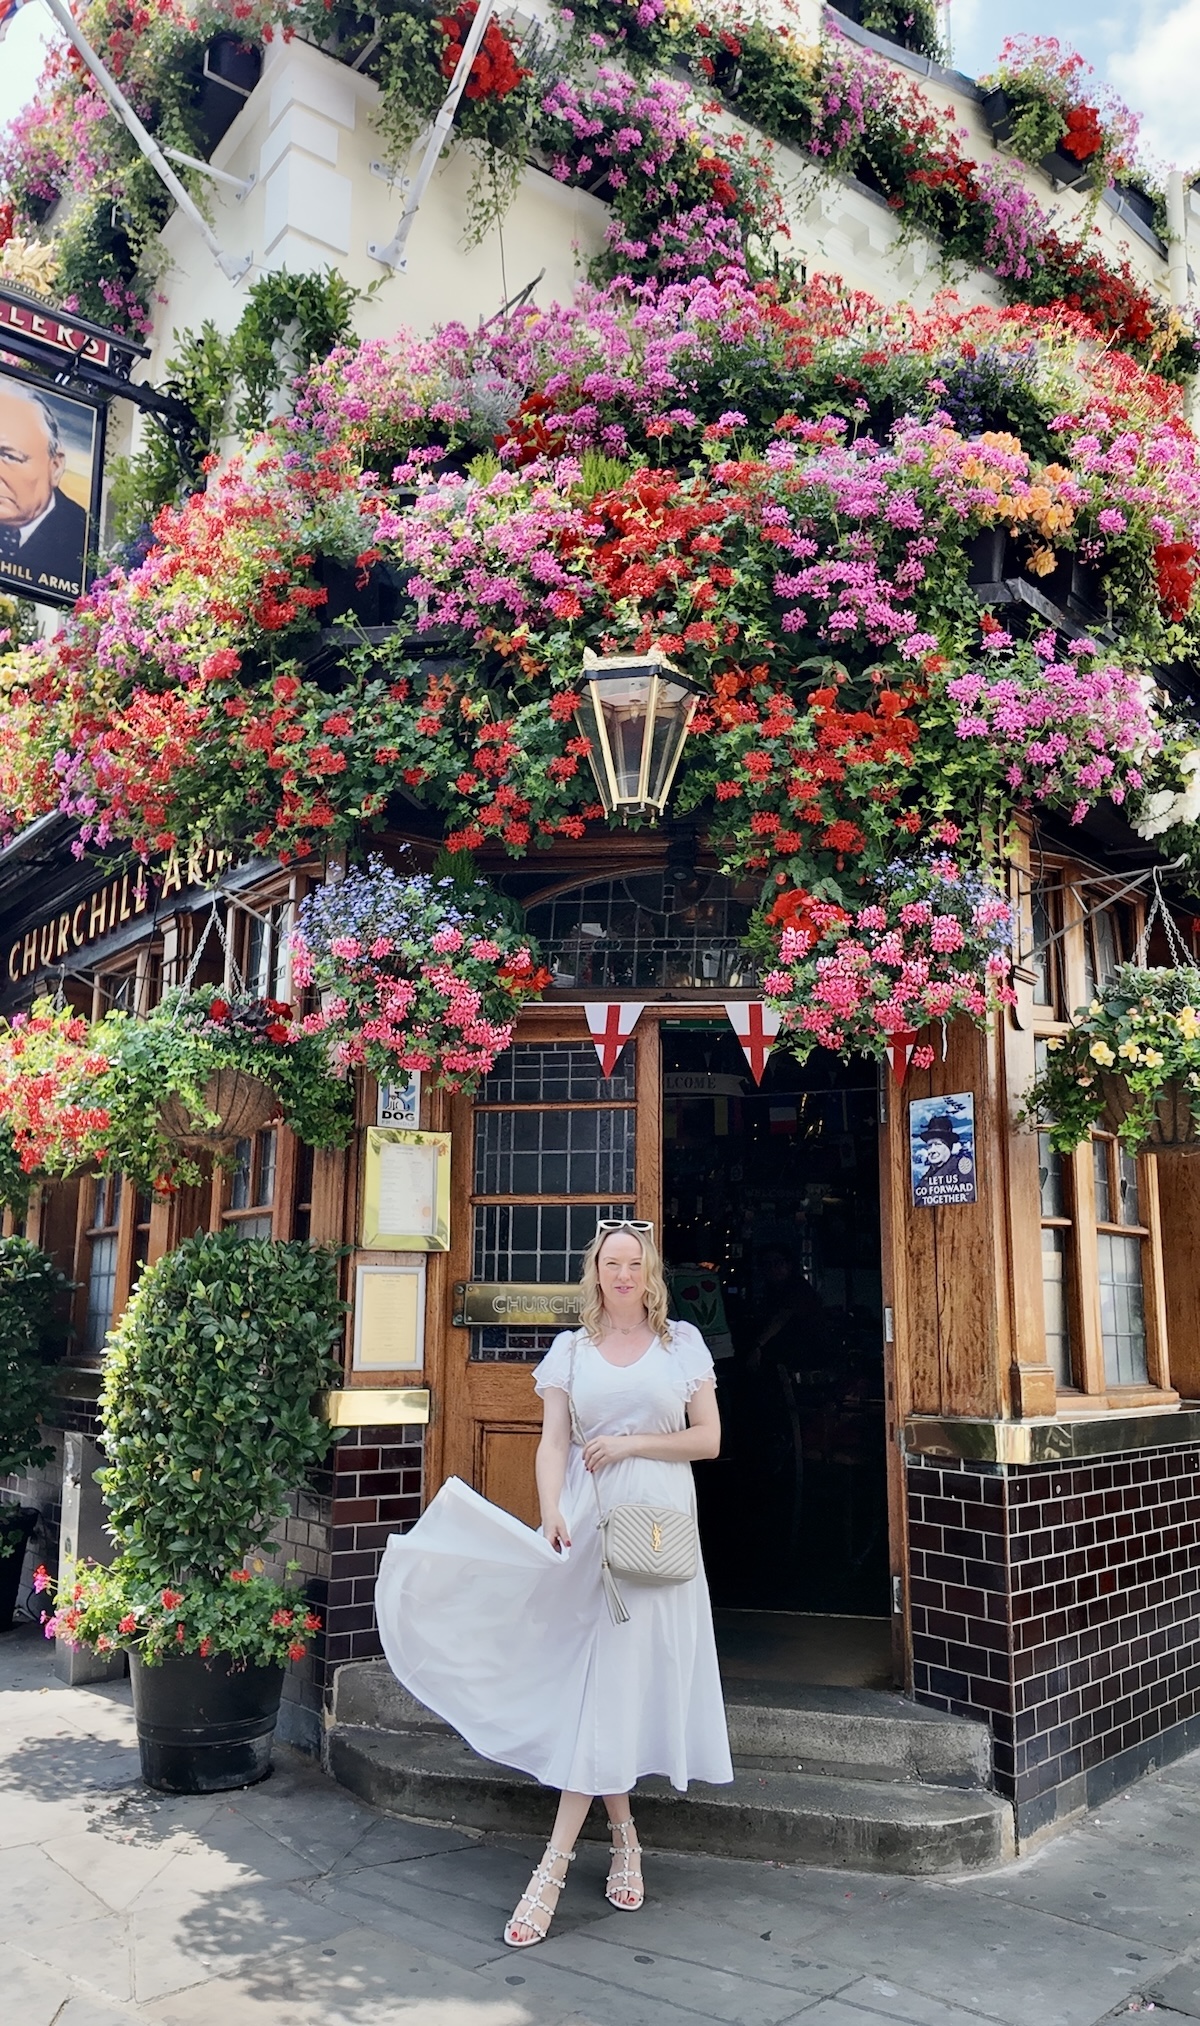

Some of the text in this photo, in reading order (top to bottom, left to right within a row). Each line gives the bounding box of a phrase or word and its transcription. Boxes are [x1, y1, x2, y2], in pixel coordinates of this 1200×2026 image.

[38, 573, 80, 595] ARMS
[8, 865, 146, 982] CHURCHILL
[382, 1110, 415, 1122] DOG
[945, 1174, 959, 1184] US
[915, 1182, 974, 1196] GO FORWARD
